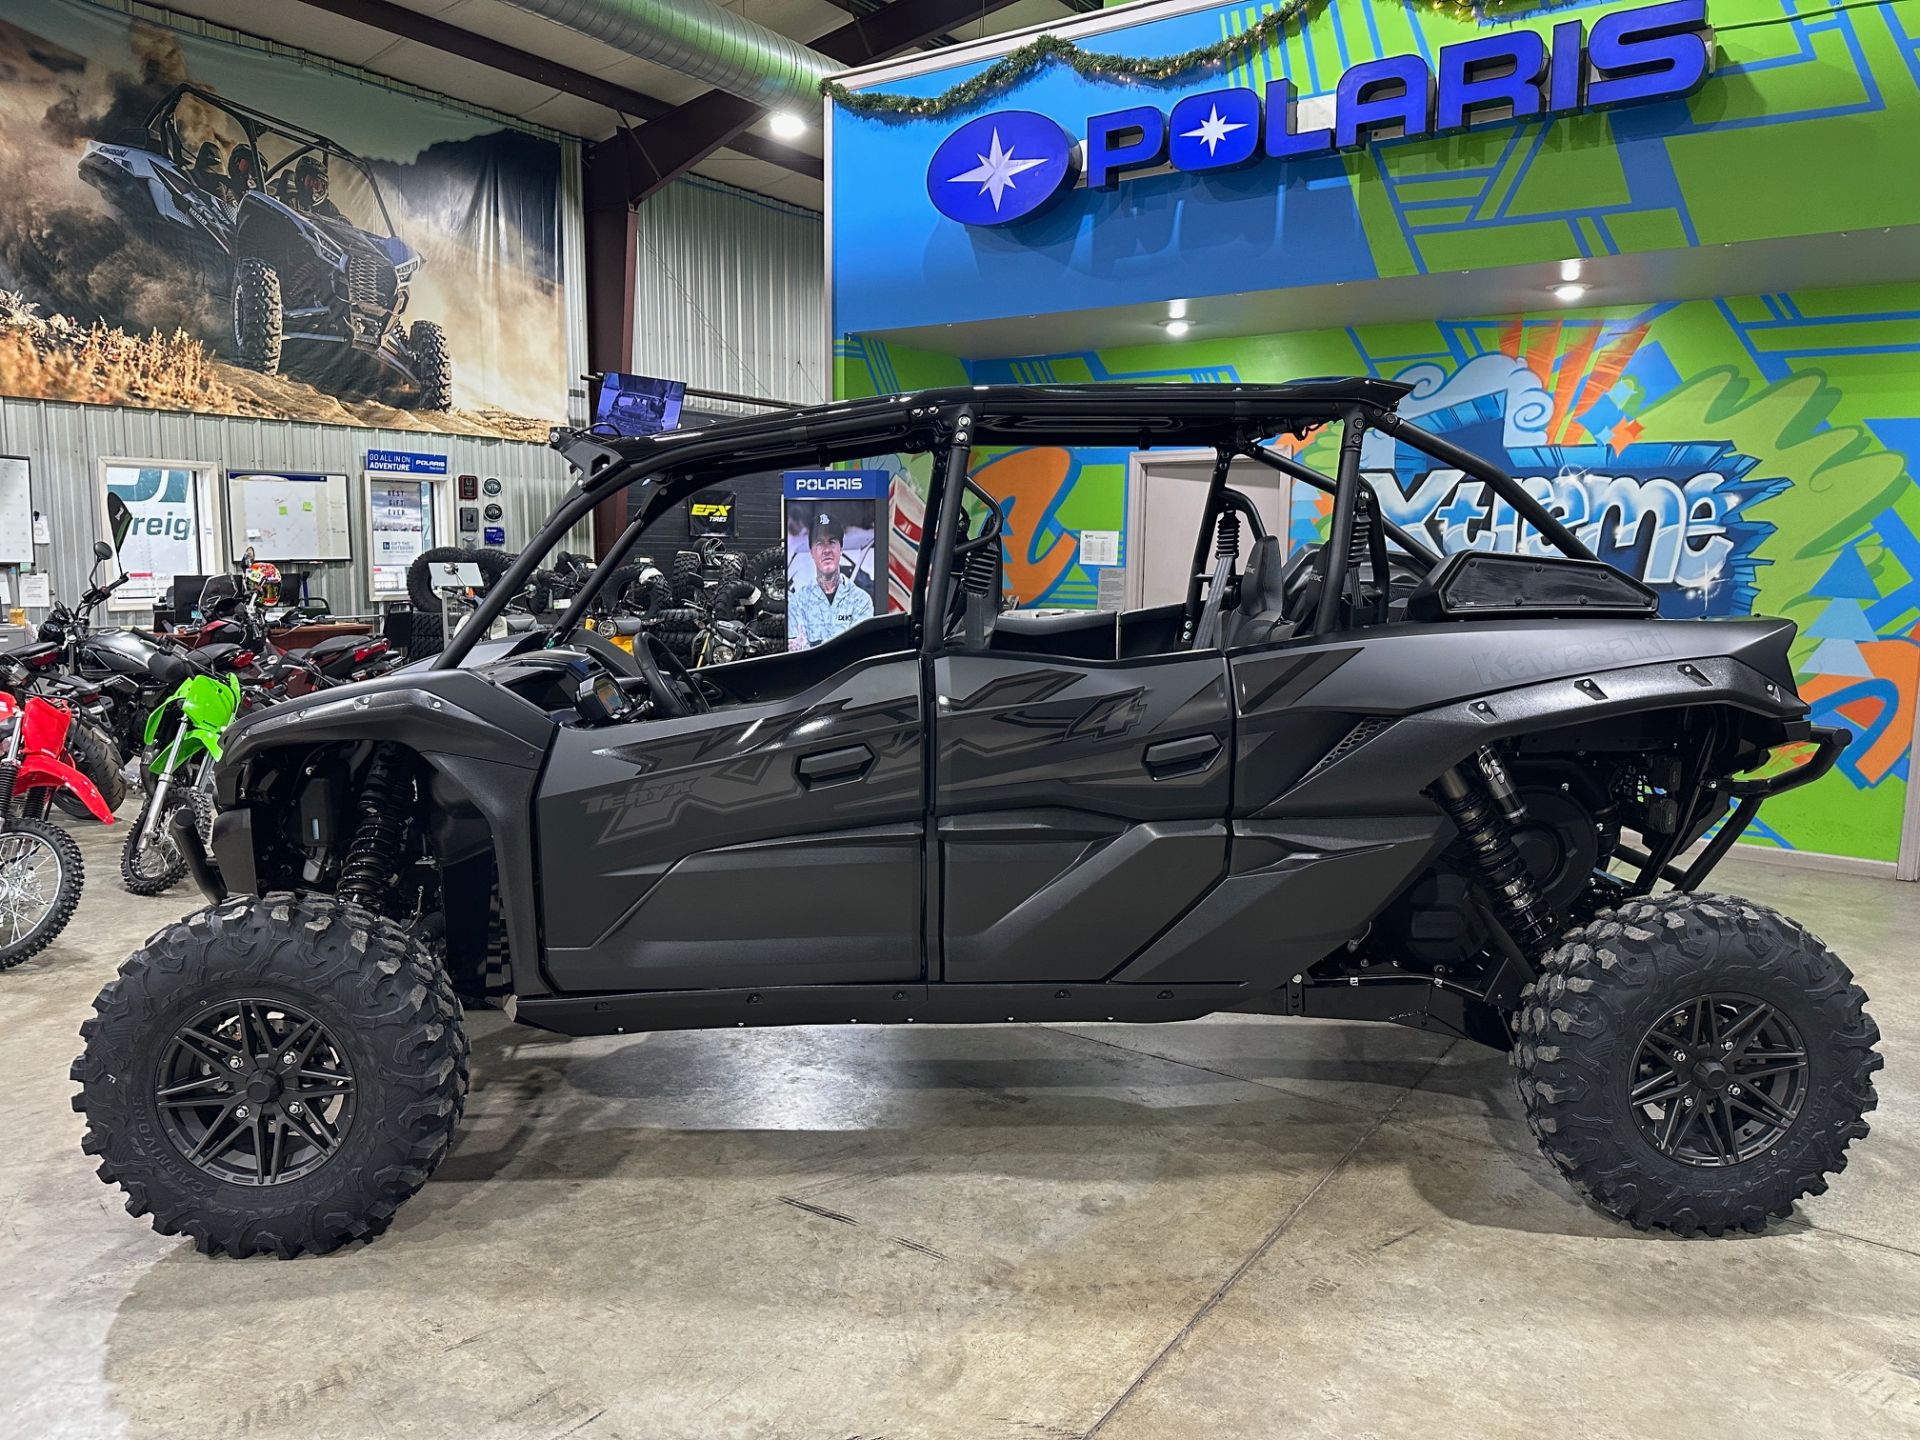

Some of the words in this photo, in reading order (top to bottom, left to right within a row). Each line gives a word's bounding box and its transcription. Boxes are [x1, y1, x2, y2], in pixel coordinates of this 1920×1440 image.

[1087, 0, 1711, 189] POLARIS
[369, 453, 379, 461] GO
[380, 454, 393, 462] ALL
[401, 456, 411, 464] ON
[415, 459, 445, 467] POLARIS
[369, 462, 411, 471] ADVENTURE
[796, 477, 863, 491] POLARIS
[691, 503, 732, 517] EFX
[131, 511, 195, 541] reig
[1472, 629, 1674, 686] Kawasaki
[132, 1096, 205, 1192] CARNIVORE
